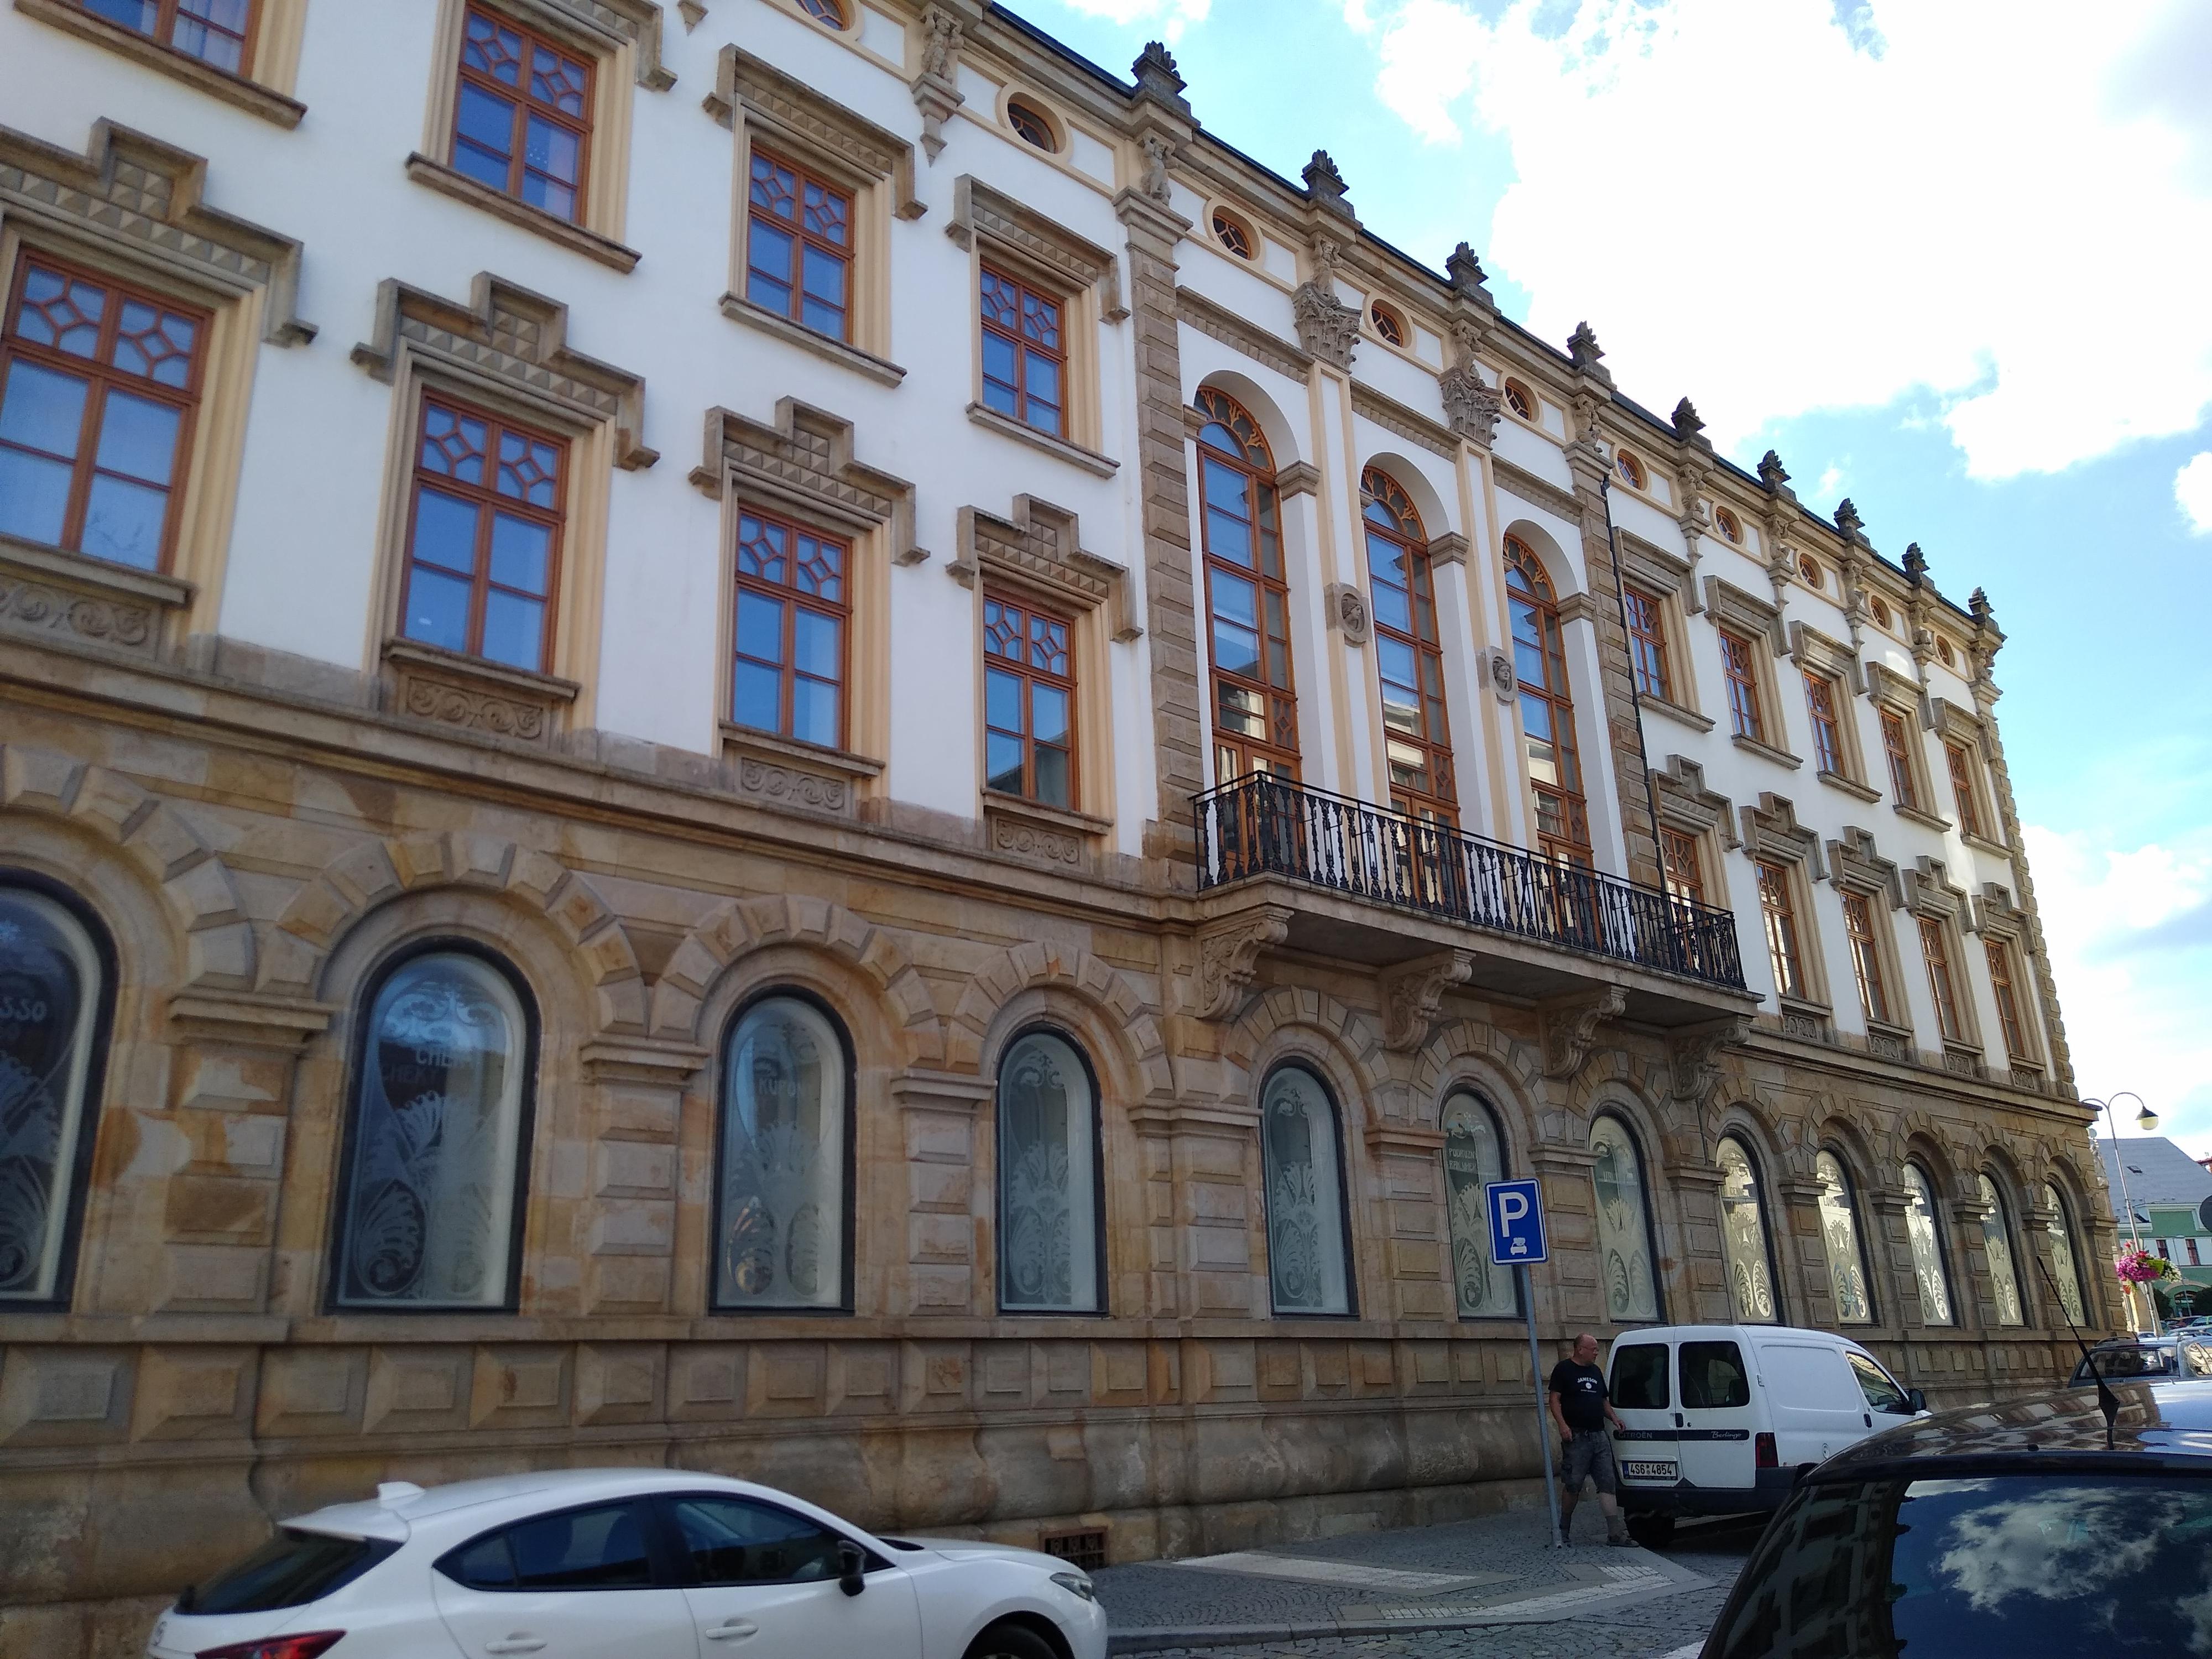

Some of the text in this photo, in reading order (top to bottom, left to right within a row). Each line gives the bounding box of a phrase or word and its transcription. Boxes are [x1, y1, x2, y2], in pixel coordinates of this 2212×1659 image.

[1498, 1192, 1528, 1238] P
[1630, 1464, 1672, 1475] 4S6 4854
